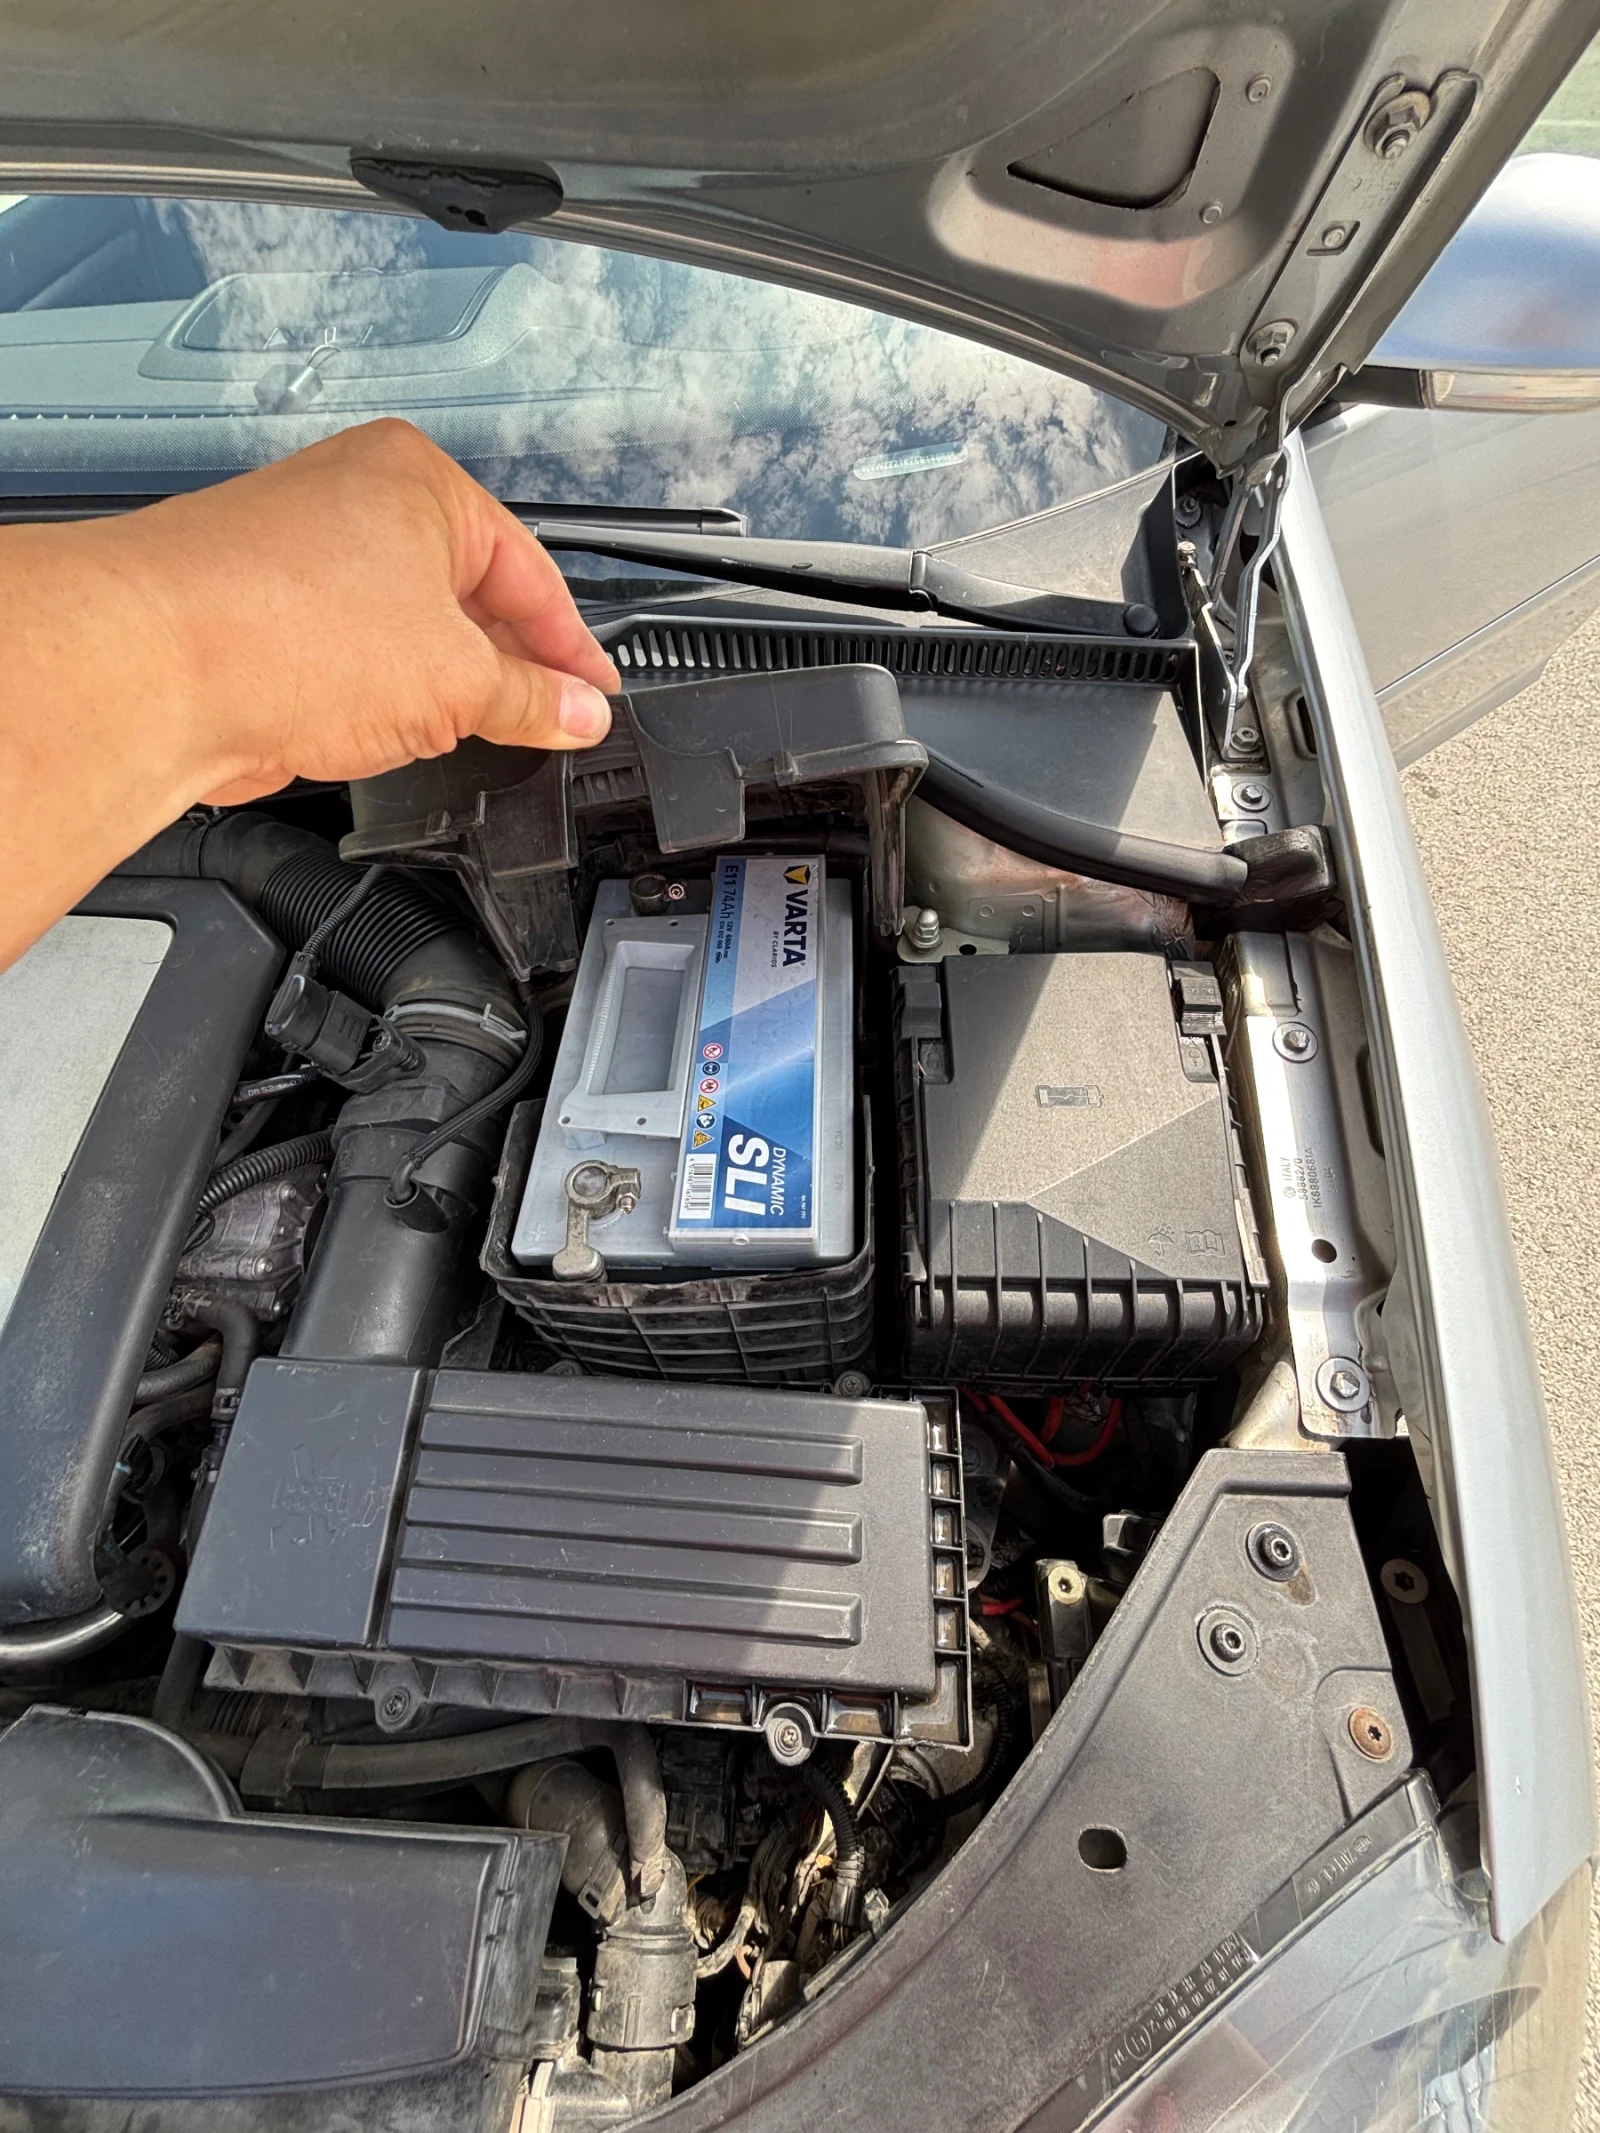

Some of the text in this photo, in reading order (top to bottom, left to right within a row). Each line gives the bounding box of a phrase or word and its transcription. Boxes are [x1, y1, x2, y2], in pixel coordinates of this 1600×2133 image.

[720, 864, 739, 919] E11 74Ah
[726, 921, 734, 932] 12V
[771, 931, 779, 968] BY CLARIOS
[783, 889, 808, 967] VARTA
[724, 1134, 770, 1215] SLI
[770, 1146, 786, 1216] DYNAMIC
